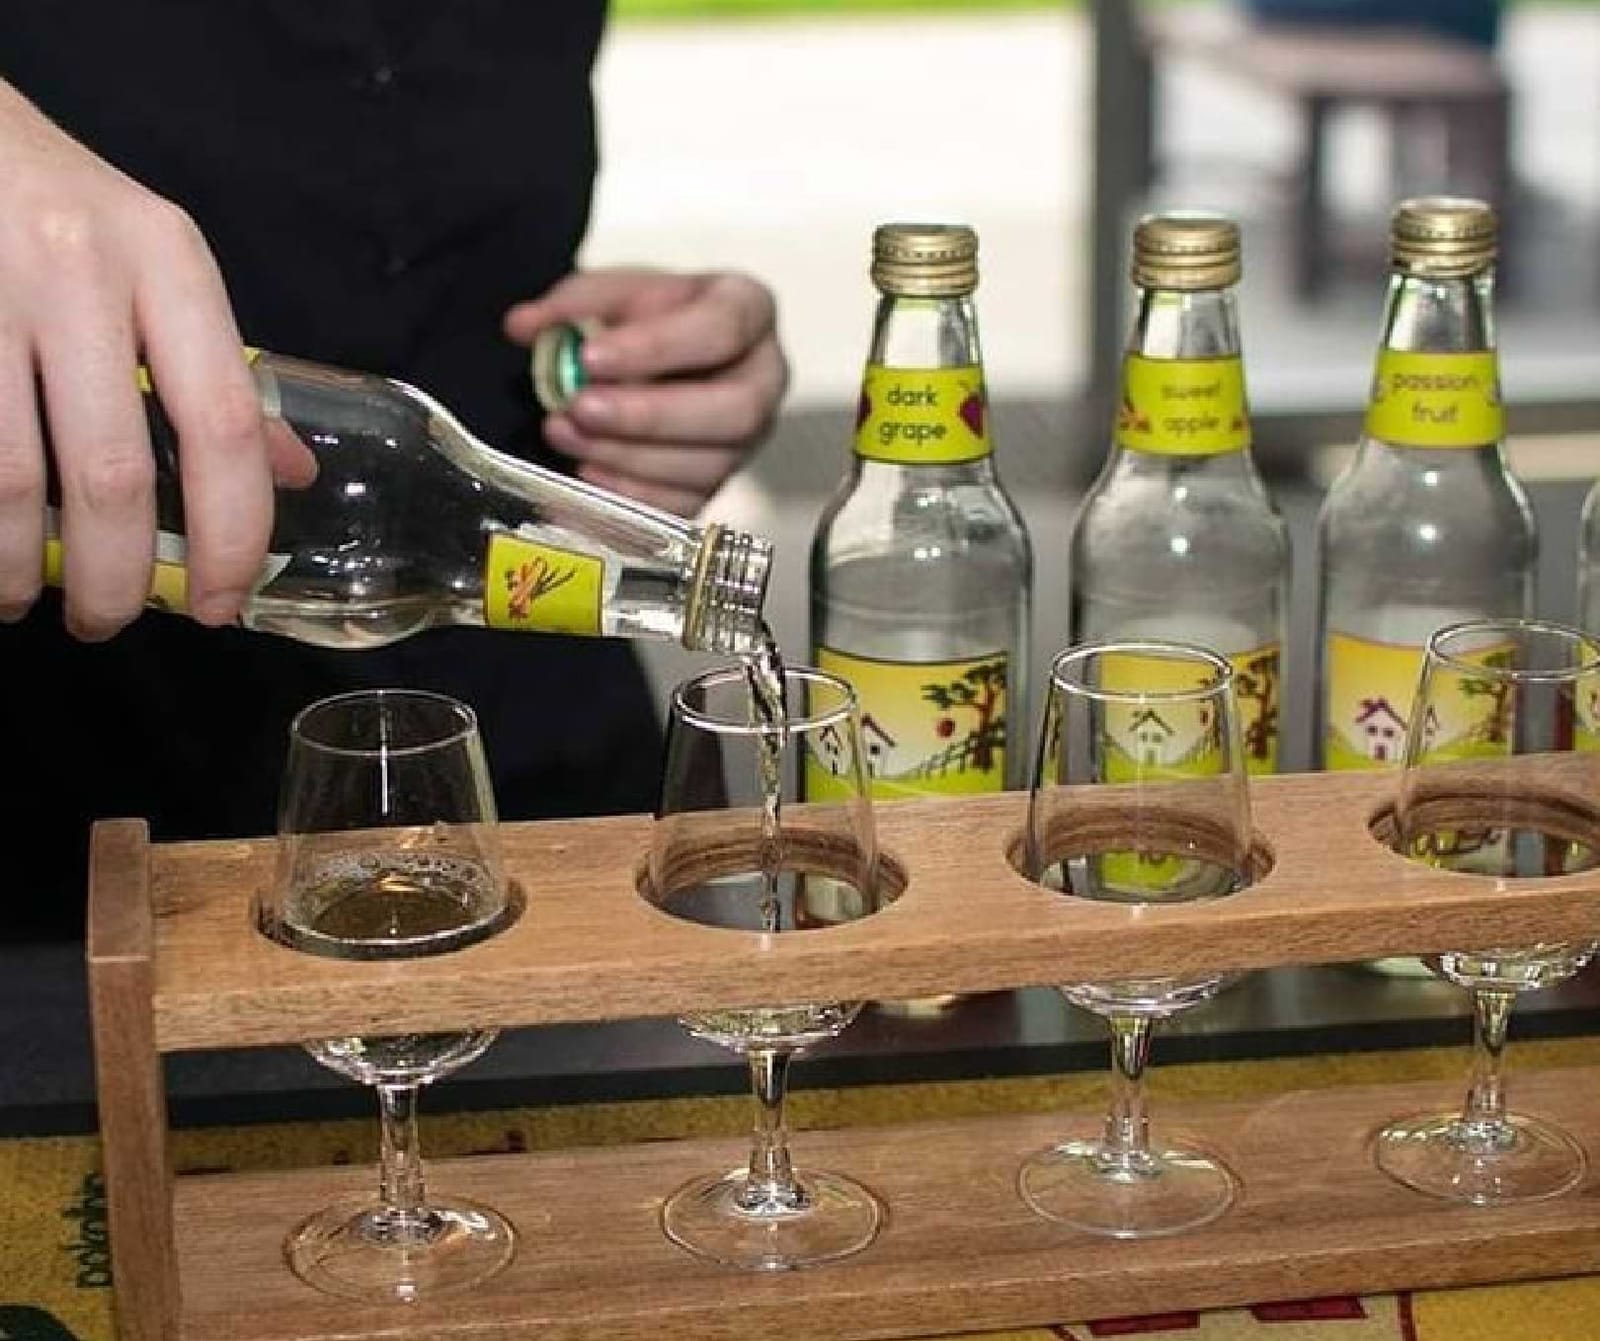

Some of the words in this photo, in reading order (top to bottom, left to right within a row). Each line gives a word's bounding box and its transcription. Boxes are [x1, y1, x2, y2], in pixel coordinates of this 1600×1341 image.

[887, 383, 938, 406] dark
[1392, 372, 1480, 396] passion
[1411, 402, 1459, 423] fruit
[879, 421, 947, 446] grape
[1162, 412, 1221, 438] apple
